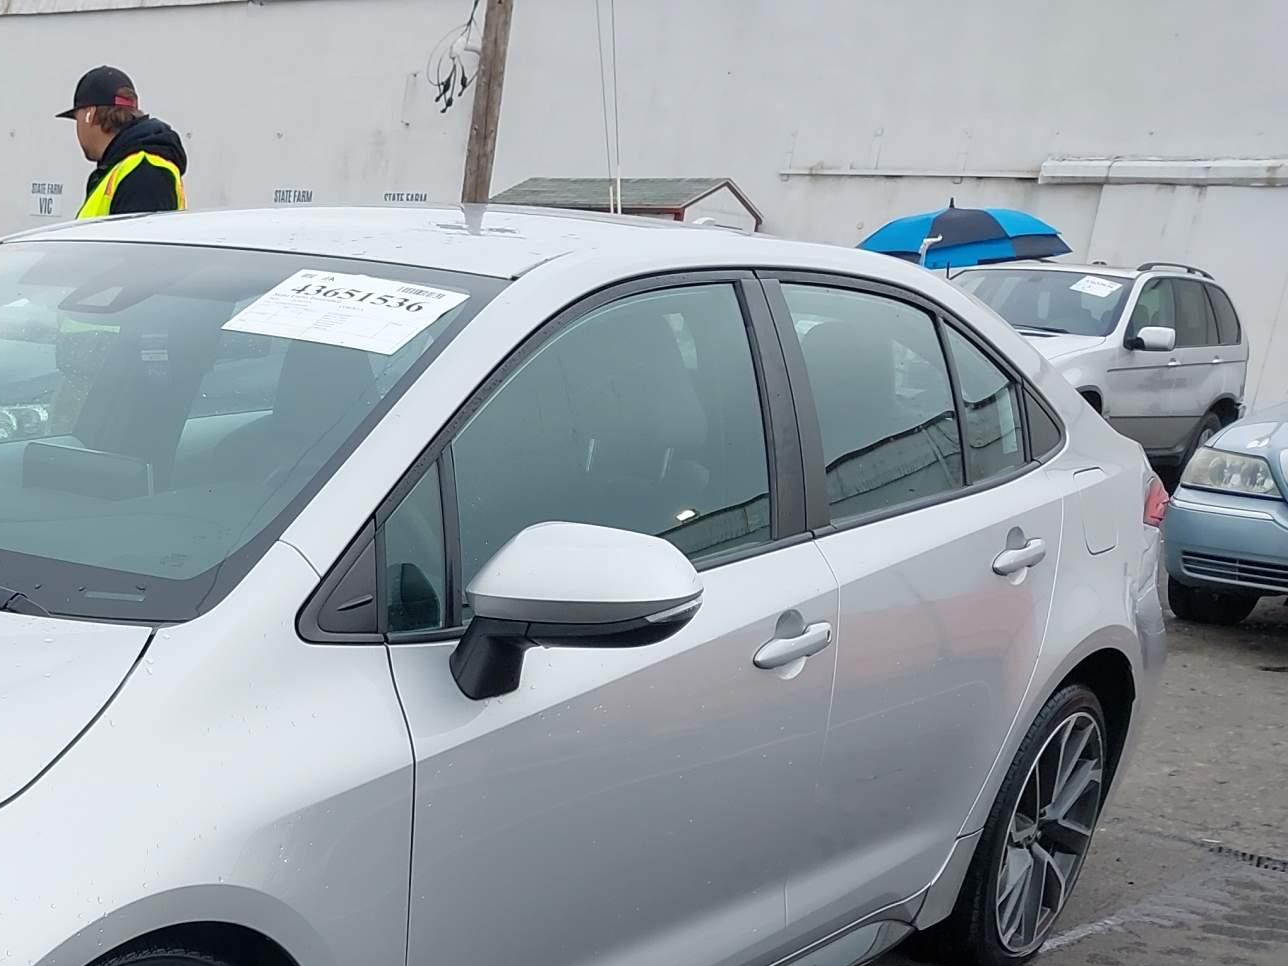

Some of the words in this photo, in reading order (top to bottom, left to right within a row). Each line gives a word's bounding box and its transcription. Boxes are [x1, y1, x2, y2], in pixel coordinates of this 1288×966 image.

[274, 189, 292, 203] STATE
[293, 190, 312, 203] FARM
[39, 197, 53, 215] VIC
[292, 282, 427, 313] 43651536
